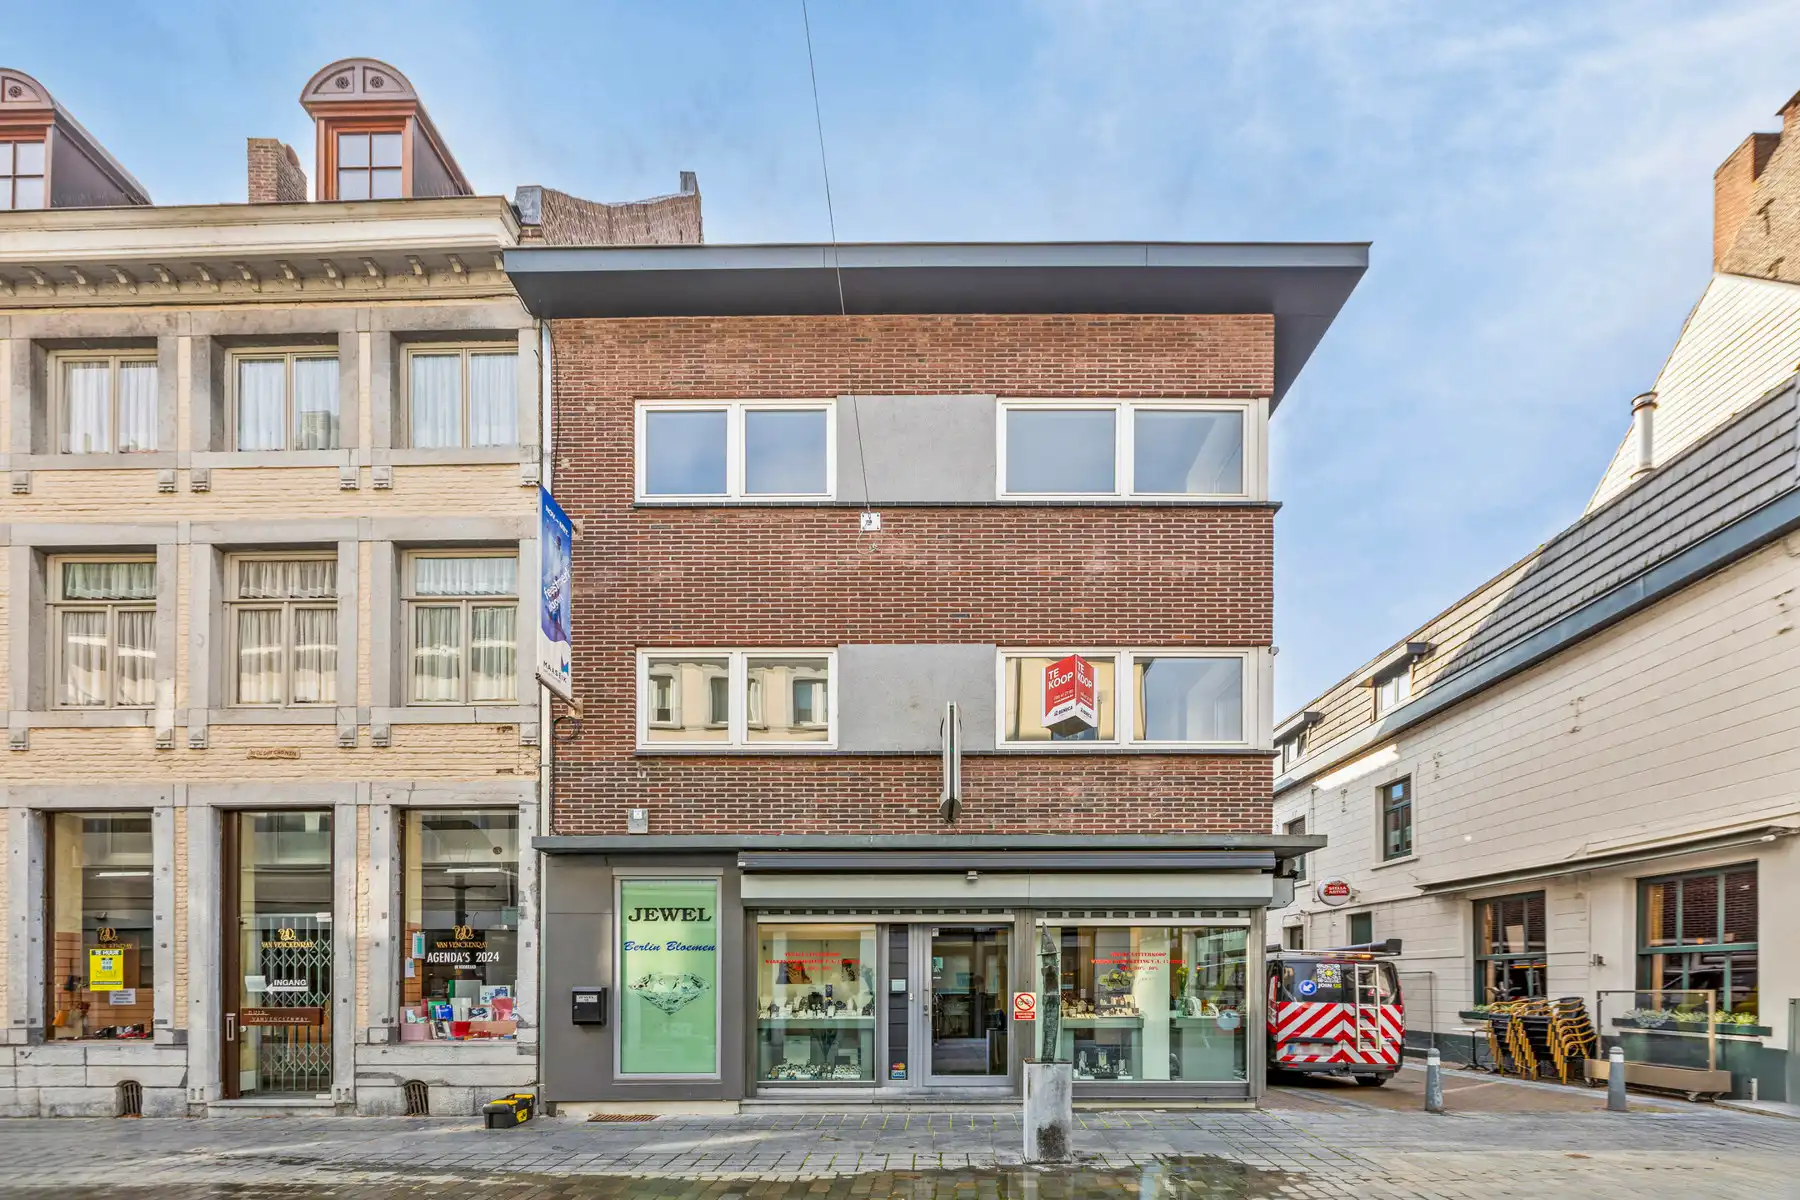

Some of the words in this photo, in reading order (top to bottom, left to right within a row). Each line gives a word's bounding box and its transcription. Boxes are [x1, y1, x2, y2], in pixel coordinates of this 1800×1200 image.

[1077, 661, 1084, 673] TE
[1048, 668, 1059, 680] TE
[1048, 672, 1073, 690] KOOP
[1077, 672, 1093, 689] KOOP
[628, 907, 712, 922] JEWEL
[436, 941, 449, 949] VAN
[623, 941, 661, 952] Berlin
[665, 941, 717, 952] Bloemen
[427, 951, 471, 963] AGENDA'S
[475, 951, 500, 963] 2024
